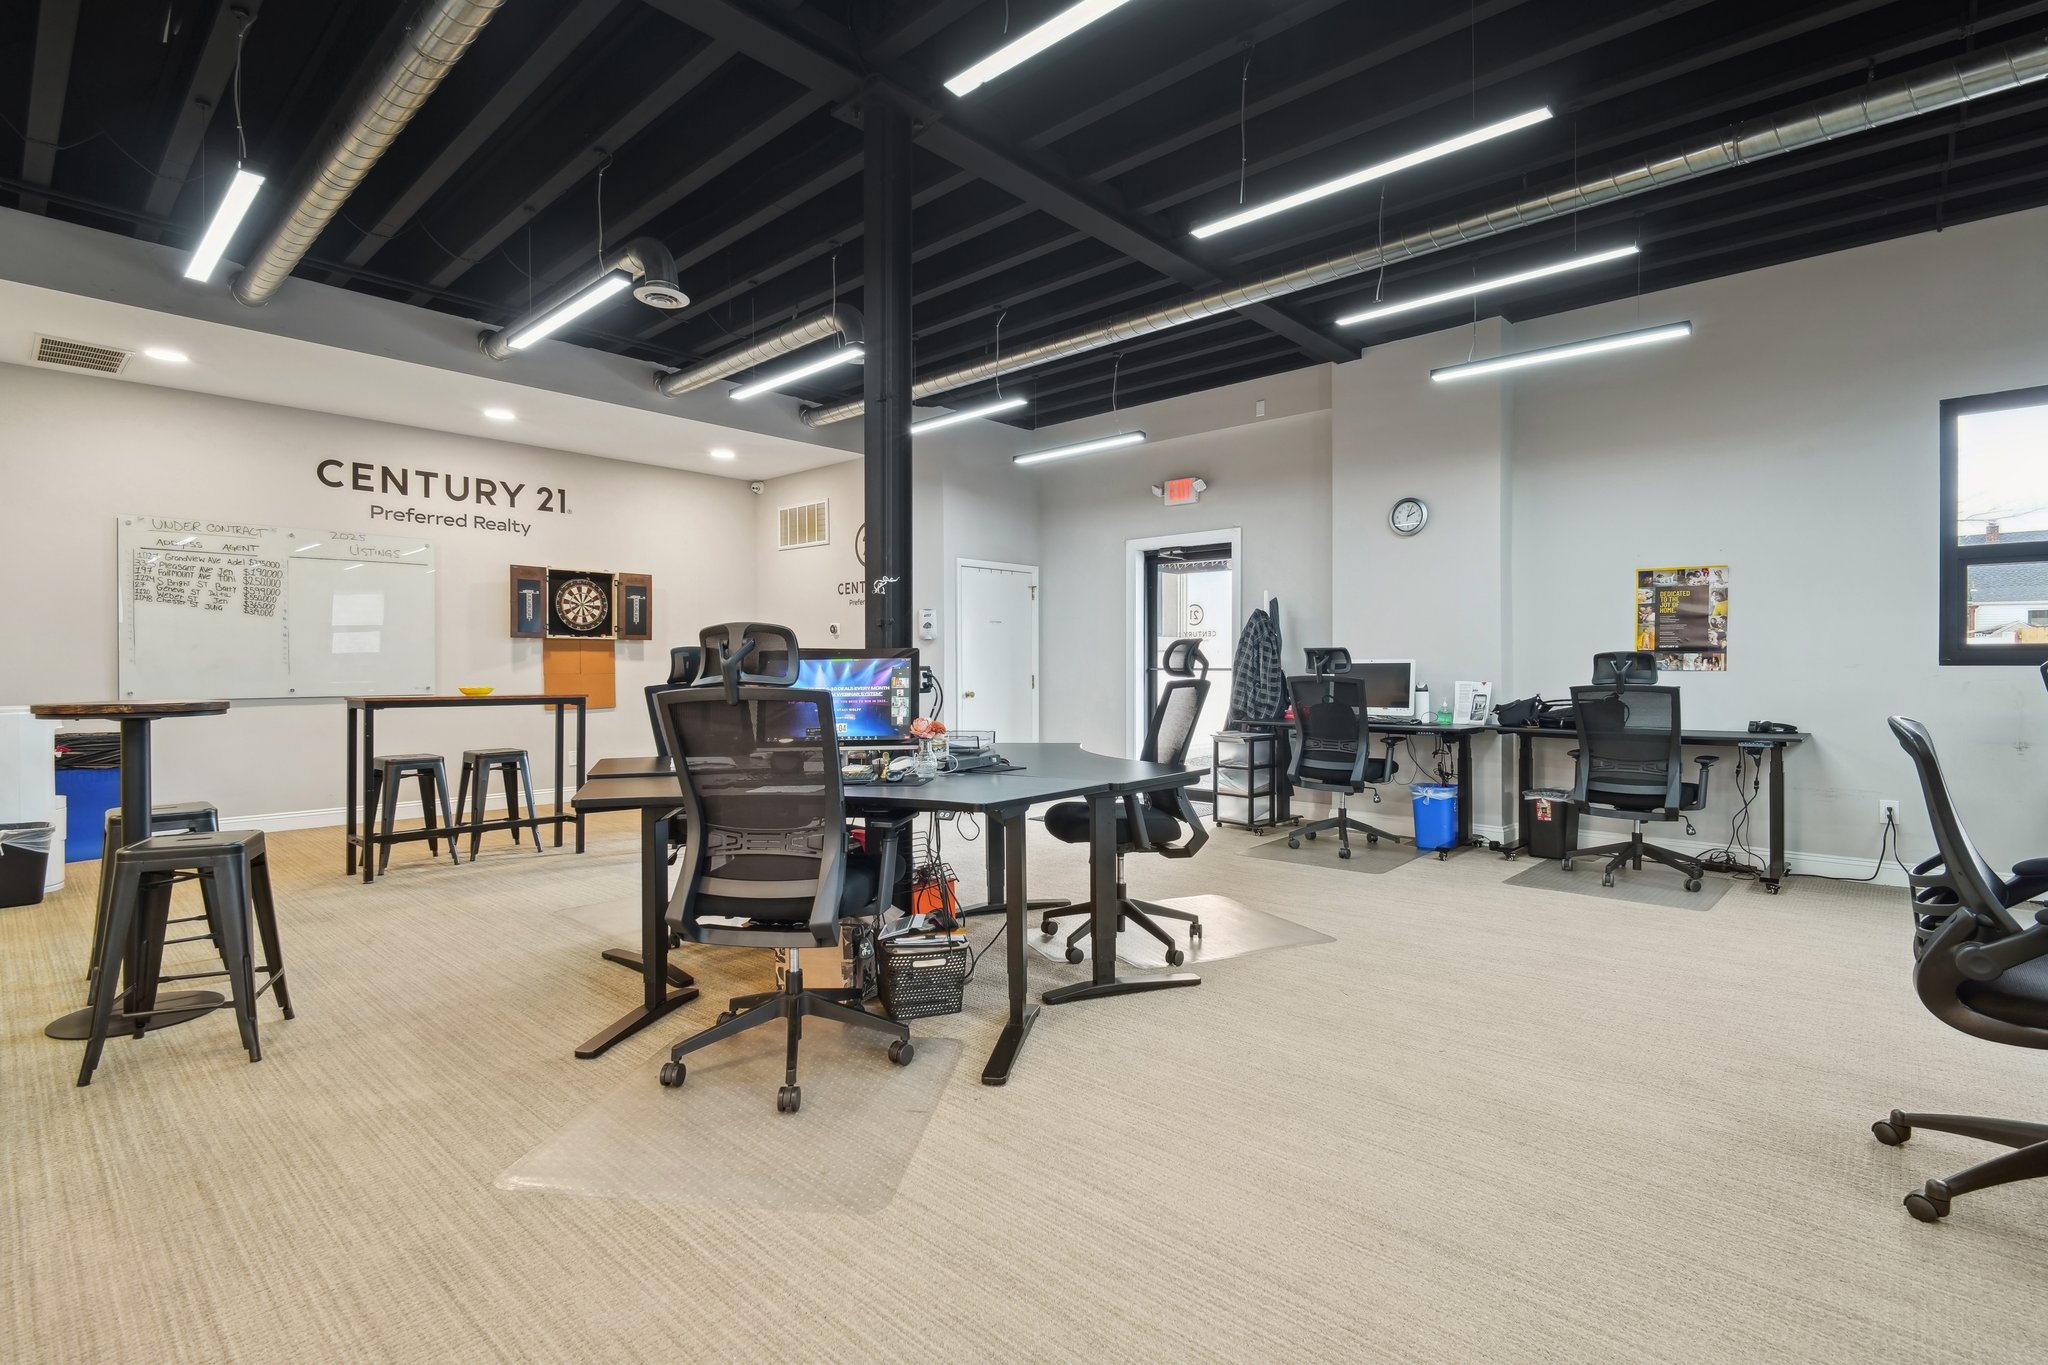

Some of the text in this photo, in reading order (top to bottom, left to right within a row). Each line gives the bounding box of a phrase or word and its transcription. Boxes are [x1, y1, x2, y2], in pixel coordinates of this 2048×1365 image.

[317, 459, 566, 514] CENTURY 21
[1169, 479, 1192, 501] EXIT
[151, 519, 268, 538] UNDER CONTRACT
[370, 505, 531, 537] Preferred Realty
[329, 531, 366, 542] 2025
[222, 543, 260, 552] AGENT
[134, 575, 155, 583] 1224
[838, 581, 865, 595] CENT
